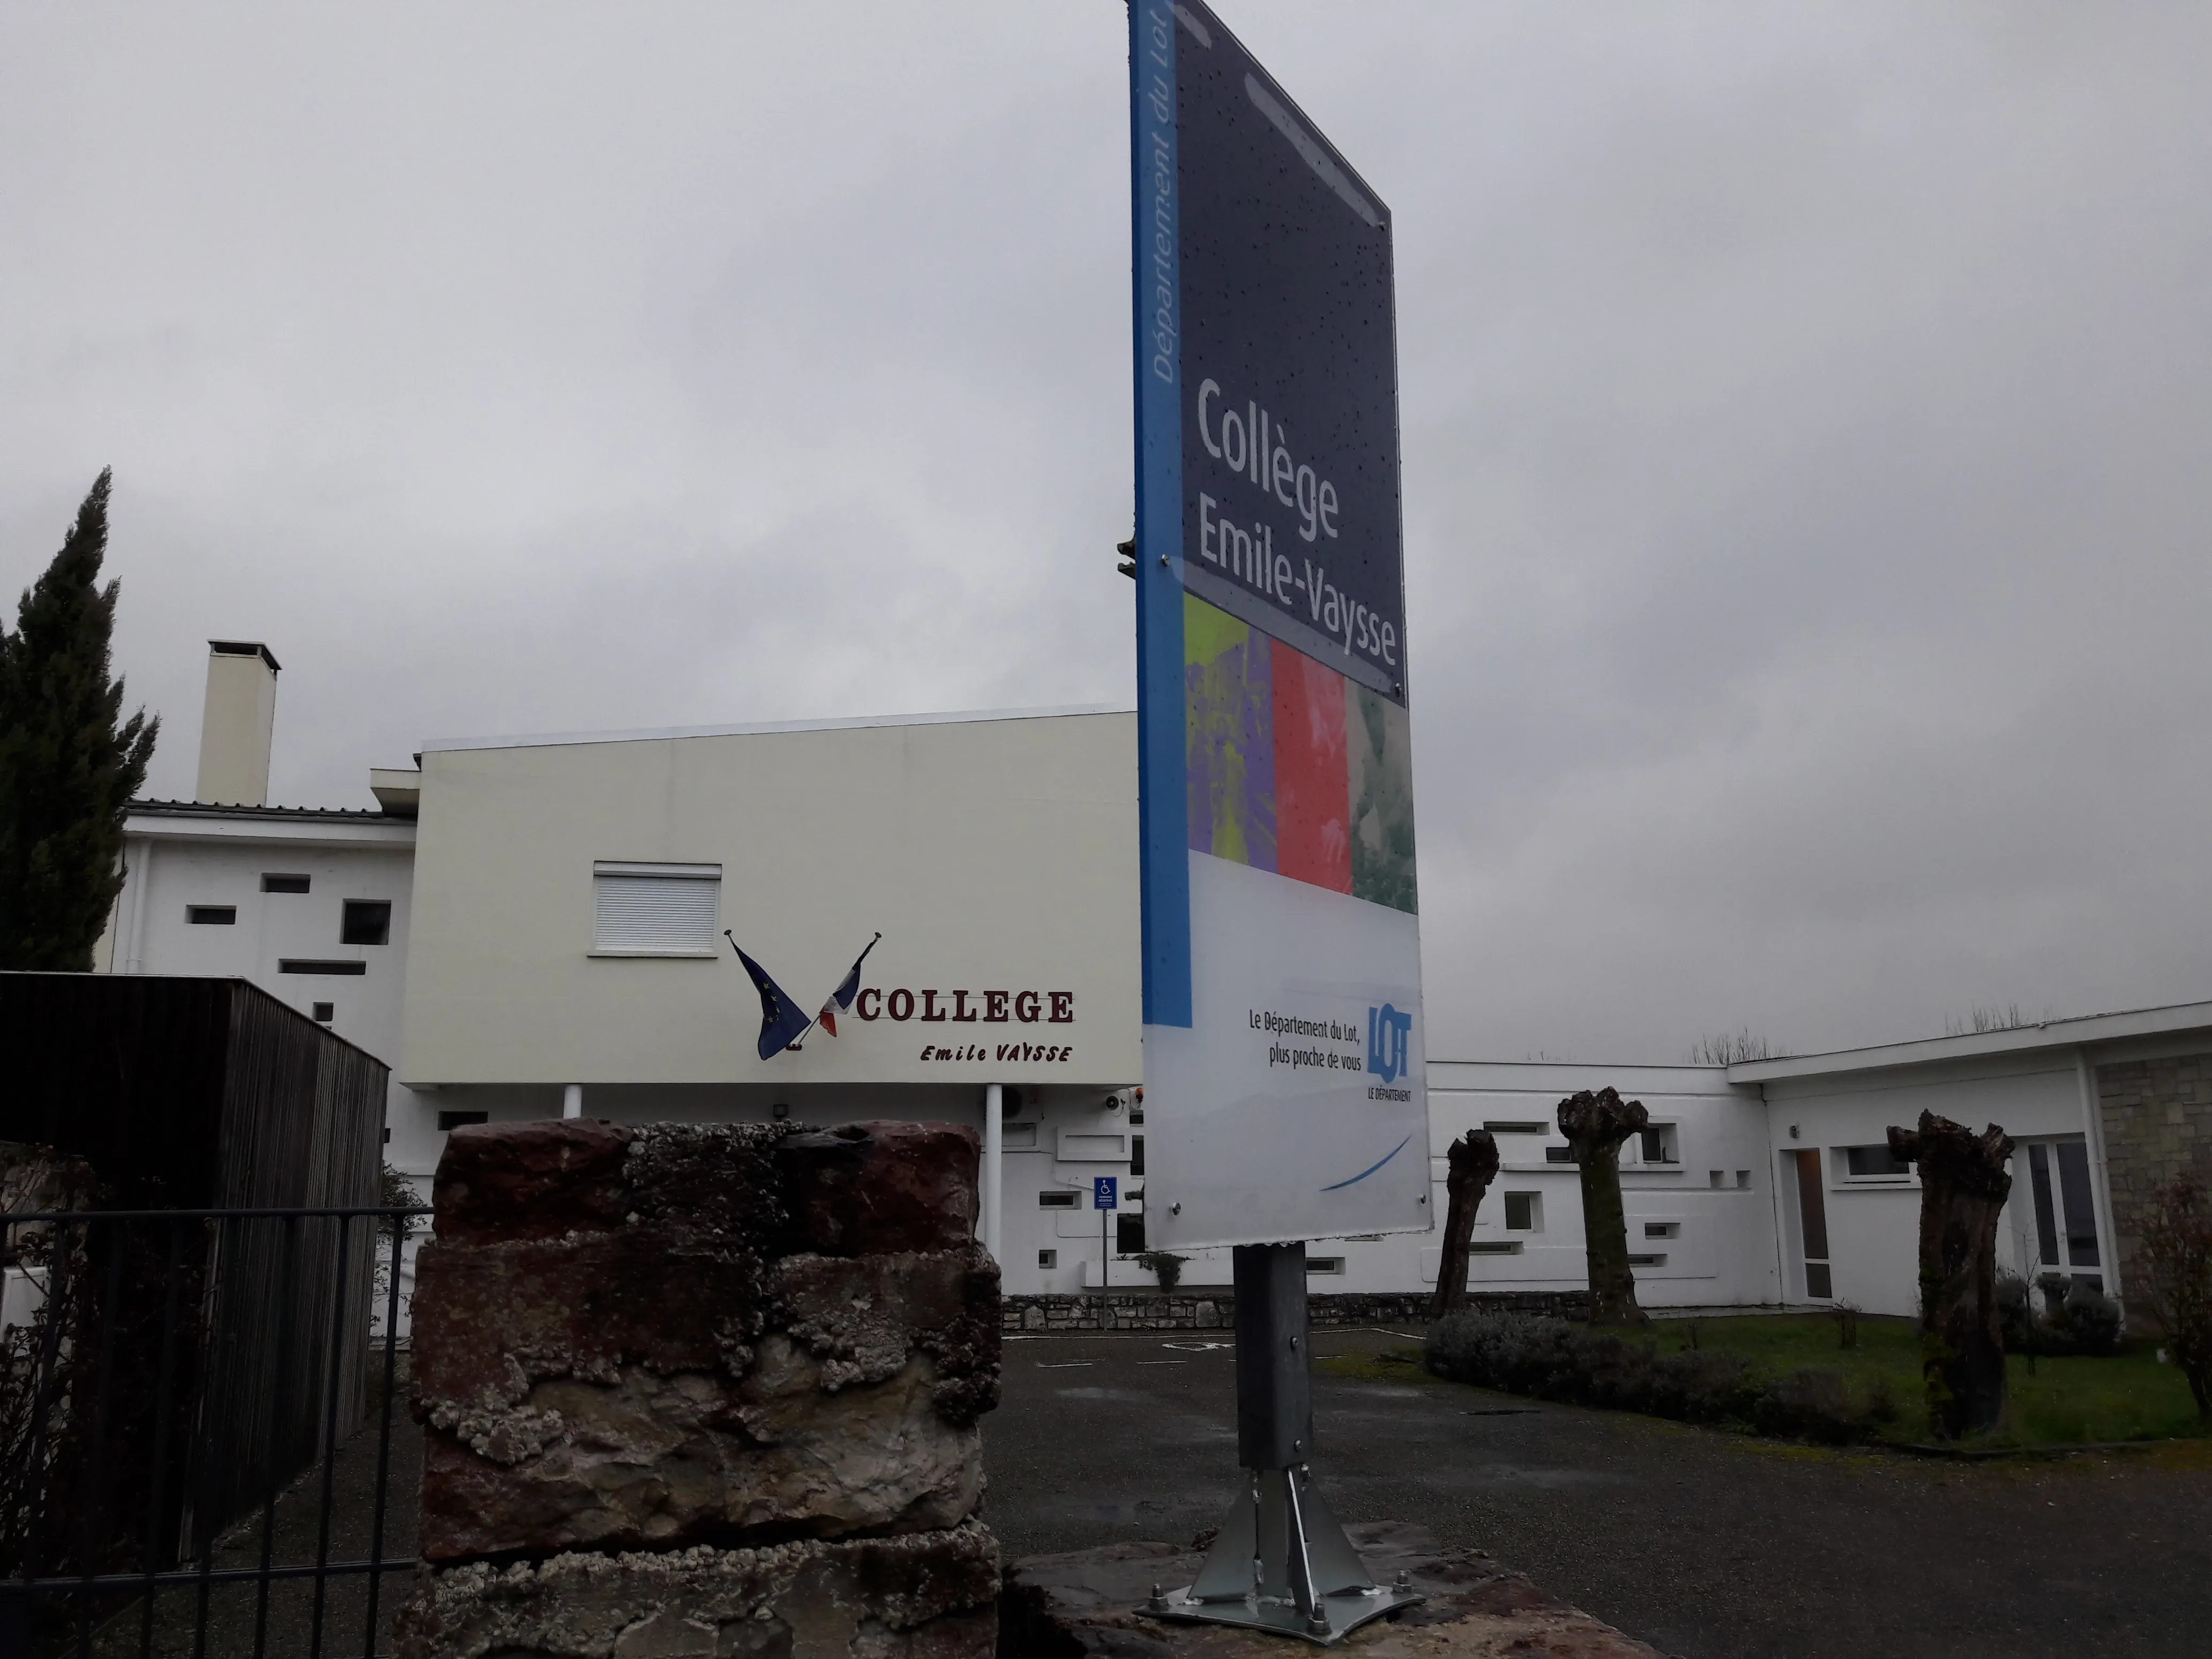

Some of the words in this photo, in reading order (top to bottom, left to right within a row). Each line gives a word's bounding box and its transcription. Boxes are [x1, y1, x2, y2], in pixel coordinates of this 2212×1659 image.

[1150, 8, 1168, 68] Lot
[1148, 74, 1169, 122] du
[1152, 130, 1177, 384] Département
[1198, 377, 1339, 543] Collège
[1199, 491, 1396, 667] Emile-Vaysse
[857, 988, 1073, 1023] COLLEGE
[1249, 1009, 1261, 1029] Le
[1265, 1011, 1328, 1038] Département
[1331, 1020, 1342, 1041] du
[1344, 1023, 1360, 1046] Lot,
[920, 1045, 987, 1062] Emile
[997, 1042, 1073, 1062] VAYSSE
[1269, 1042, 1290, 1067] plus
[1293, 1046, 1324, 1070] proche
[1327, 1049, 1339, 1069] de
[1341, 1055, 1362, 1071] vous
[1367, 1003, 1413, 1083] LOT
[1368, 1087, 1374, 1100] LE
[1376, 1085, 1411, 1102] DÉPARTEMENT
